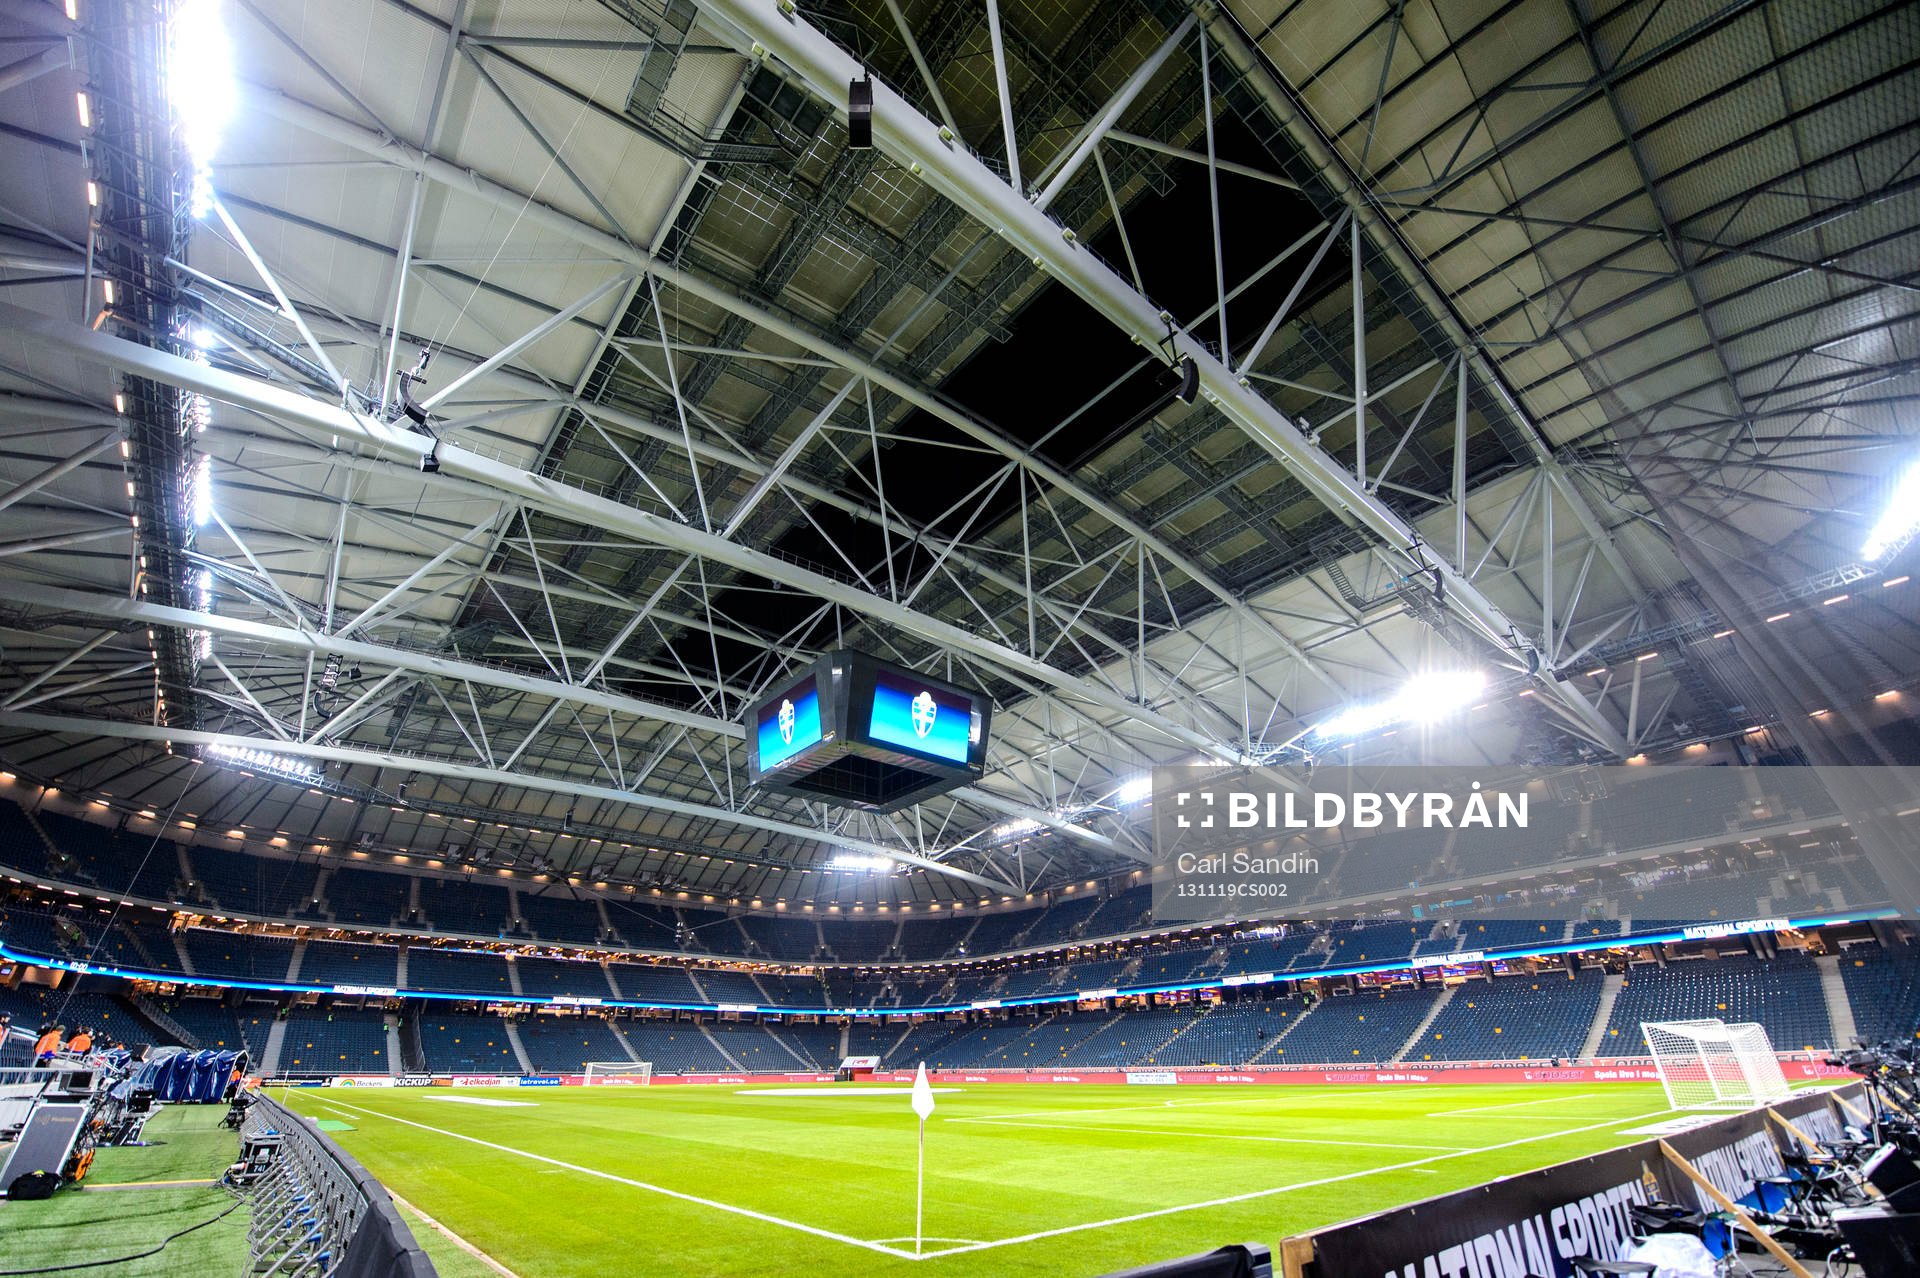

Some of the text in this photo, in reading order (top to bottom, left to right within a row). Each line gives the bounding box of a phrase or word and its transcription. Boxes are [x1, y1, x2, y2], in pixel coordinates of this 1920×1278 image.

[1594, 1070, 1617, 1080] Spela
[1618, 1069, 1635, 1079] live
[394, 1078, 432, 1087] KICKUP
